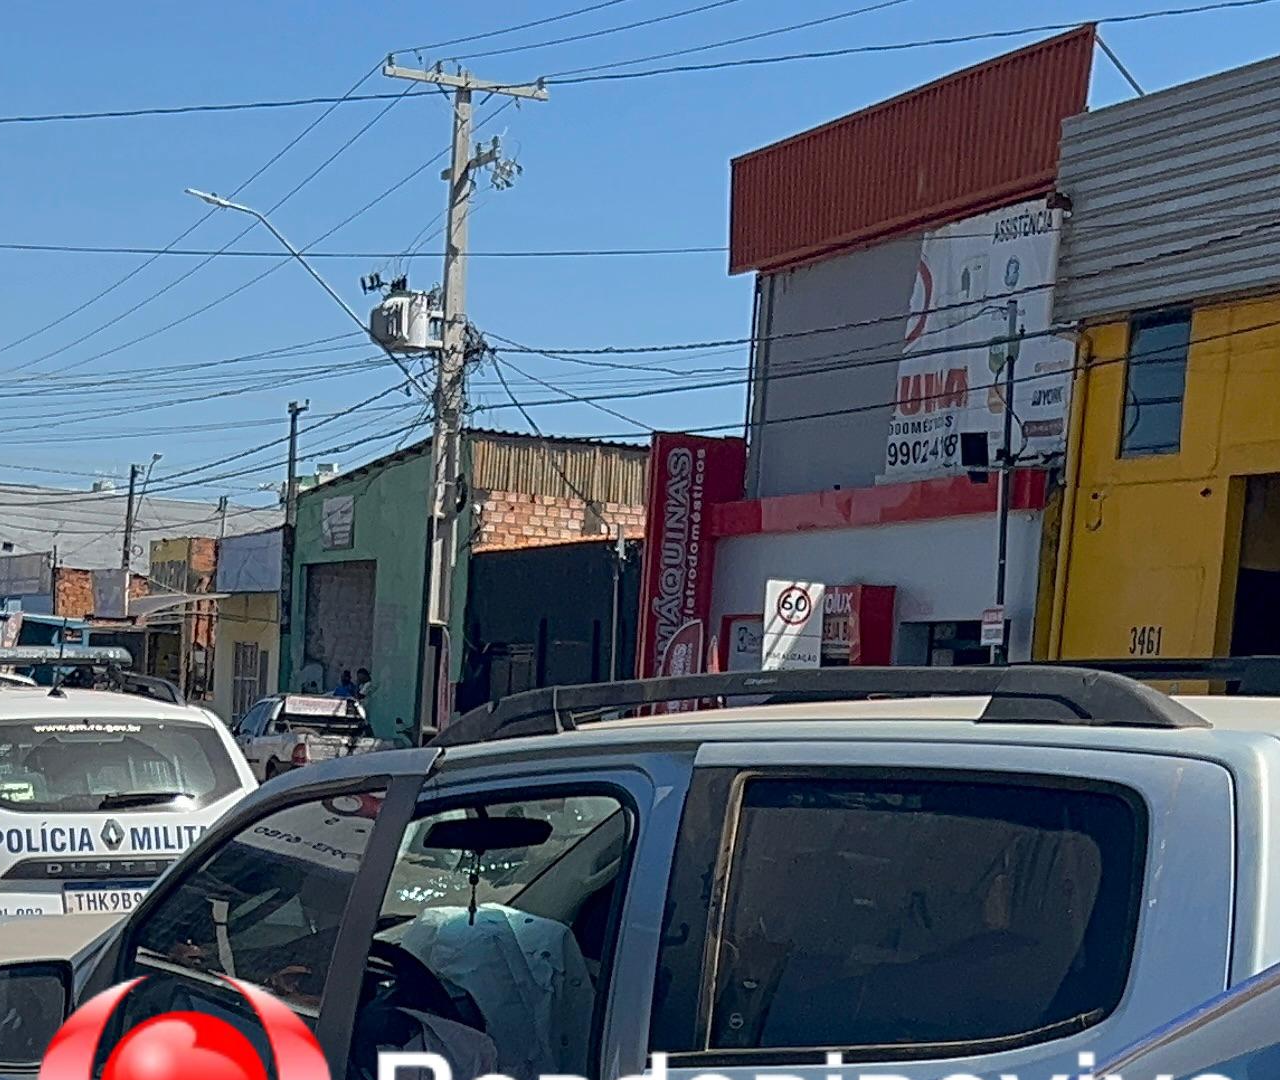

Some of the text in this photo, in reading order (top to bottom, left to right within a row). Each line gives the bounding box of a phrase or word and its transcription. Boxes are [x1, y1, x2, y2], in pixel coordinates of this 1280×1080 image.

[991, 208, 1053, 245] ASSISTÊNCIA
[653, 447, 694, 668] MÁQUINAS
[781, 592, 808, 612] 60
[1129, 626, 1162, 656] 3461
[46, 861, 176, 874] DUSTE
[74, 891, 144, 911] THK9B9
